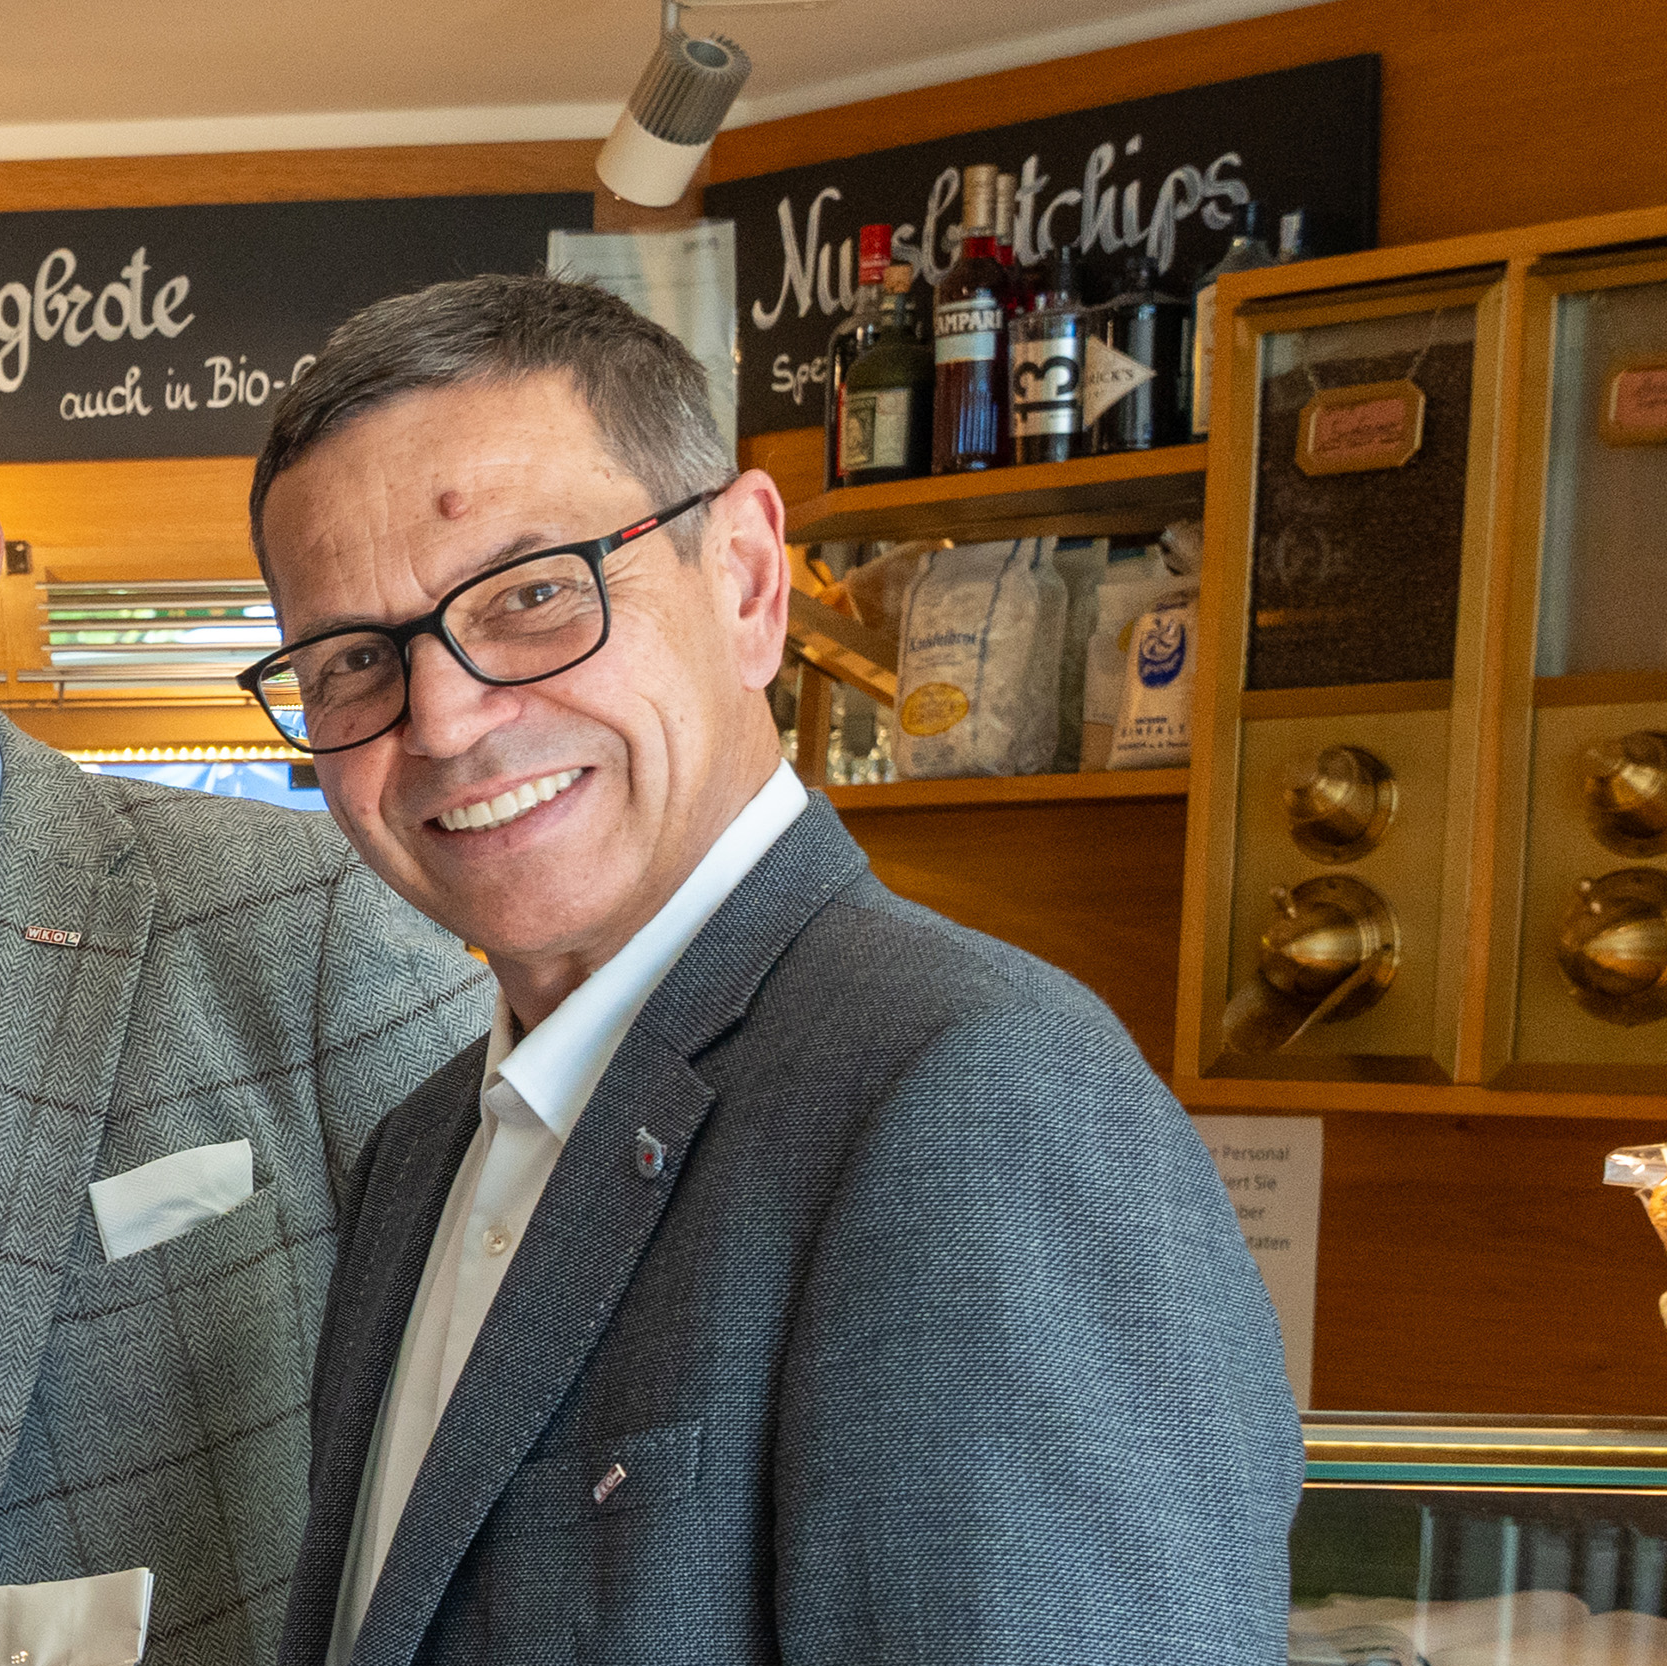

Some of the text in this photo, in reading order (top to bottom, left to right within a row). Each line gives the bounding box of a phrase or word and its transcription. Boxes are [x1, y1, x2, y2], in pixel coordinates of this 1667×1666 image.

[935, 308, 1004, 337] AMPARI
[60, 365, 153, 421] auch
[165, 368, 198, 412] in
[204, 352, 317, 409] Bio-
[770, 352, 830, 406] Spe
[27, 927, 65, 943] WKO
